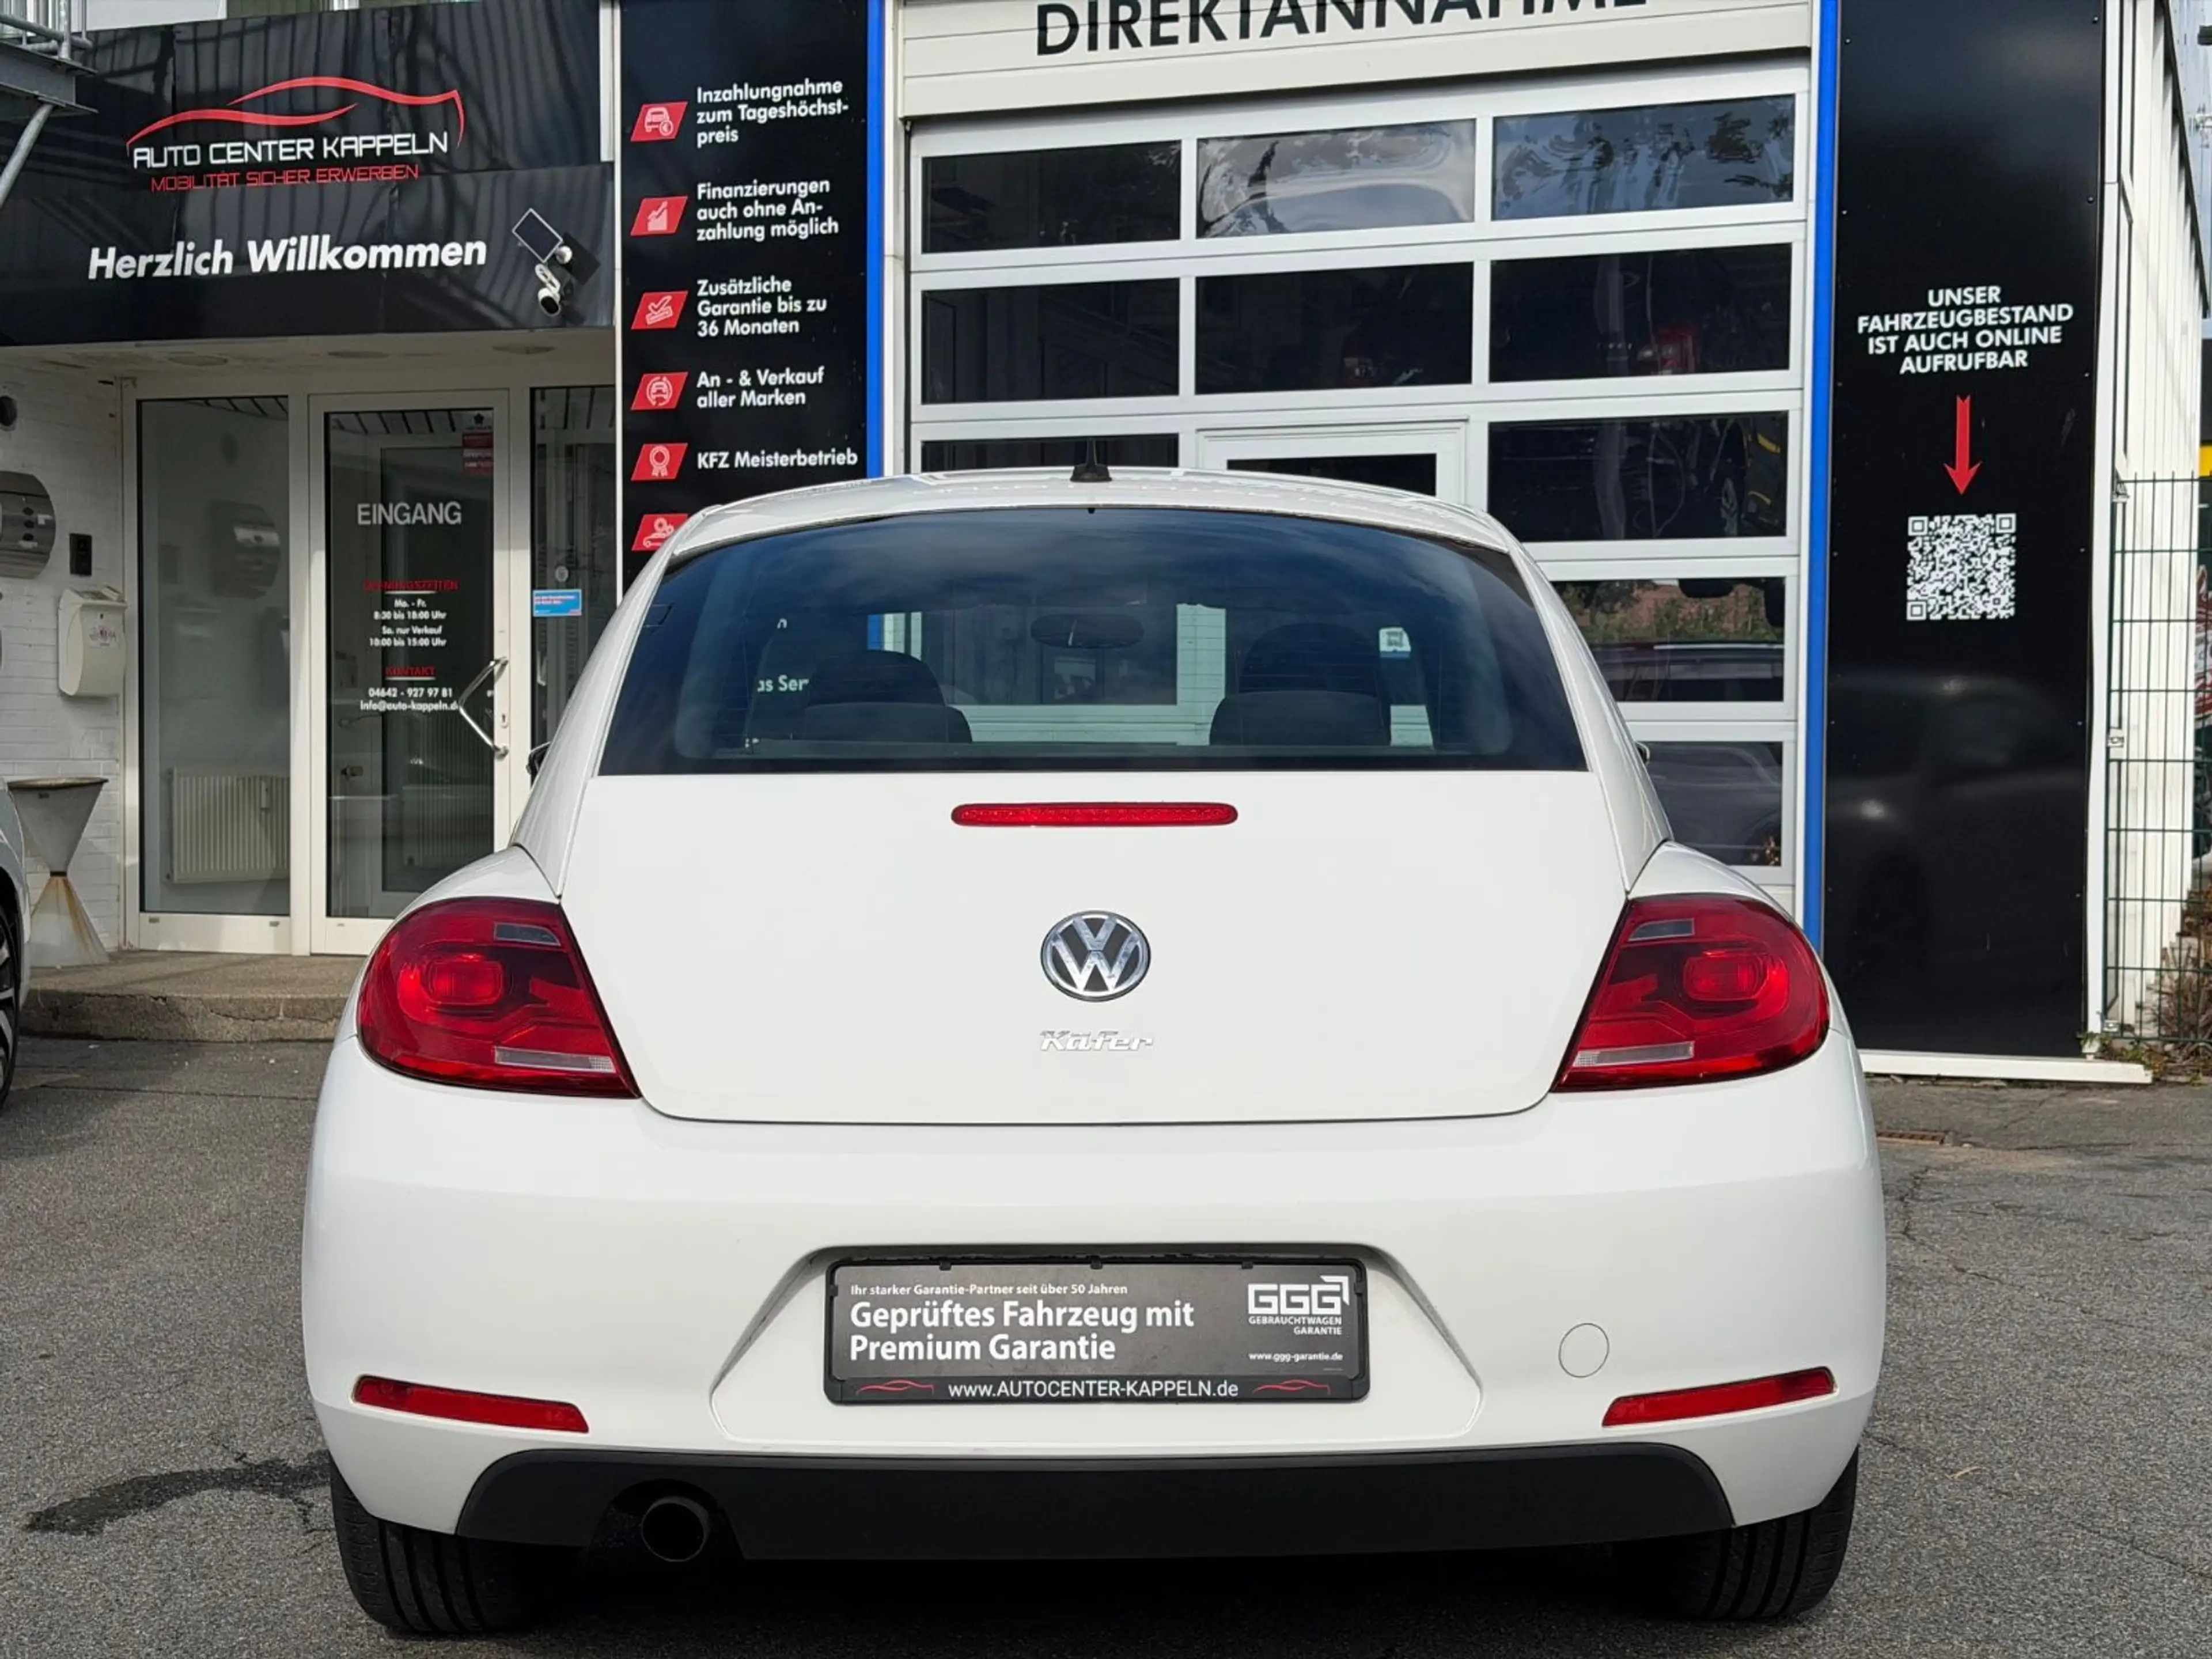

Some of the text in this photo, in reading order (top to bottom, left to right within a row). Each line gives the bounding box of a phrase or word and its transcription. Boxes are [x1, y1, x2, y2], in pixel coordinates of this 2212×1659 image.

[1037, 0, 1646, 55] DIREKTANN
[698, 78, 843, 103] Inzahlungnahme
[697, 98, 849, 123] zum Tageshöchst-
[698, 125, 738, 148] preis
[134, 131, 447, 169] AUTO CENTER KAPPELN
[247, 169, 310, 186] SICHER
[315, 165, 419, 183] ERWERBEN
[698, 179, 830, 200] Finanzierungen
[697, 198, 823, 221] auch ohne An-
[697, 217, 838, 241] zahlung möglich
[89, 234, 486, 279] Herzlich Willkommen
[698, 275, 791, 296] Zusätzliche
[1929, 286, 2000, 306] UNSER
[698, 296, 826, 316] Garantie bis zu
[698, 319, 799, 336] 36 Monaten
[1858, 304, 2073, 334] FAHRZEUGBESTAND
[1869, 326, 2061, 354] IST AUCH ONLINE
[1900, 350, 2027, 374] AUFRUFBAR
[697, 372, 720, 388] An
[739, 370, 751, 386] &
[757, 366, 824, 385] Verkauf
[697, 388, 805, 408] aller Marken
[698, 448, 858, 468] KFZ Meisterbetrieb
[358, 502, 461, 525] EINGANG
[393, 611, 404, 619] bis
[431, 611, 446, 619] Uhr
[412, 626, 442, 634] Verkauf
[393, 638, 404, 646] bis
[431, 638, 446, 646] Uhr
[407, 688, 424, 697] 927
[427, 688, 438, 697] 97
[441, 688, 453, 697] 81
[851, 1283, 1127, 1295] Ihr starker Garantie-Partner seit über 50 Jahren
[1248, 1285, 1341, 1315] GGG
[851, 1300, 1194, 1334] Geprüftes Fahrzeug mit
[1248, 1317, 1342, 1325] GEBRAUCHTWAGEN
[851, 1333, 1115, 1360] Premium Garantie
[1248, 1352, 1343, 1362] www.ggg-garantie.de
[949, 1379, 1238, 1397] www.AUTOCENTER-KAPPELN.de
